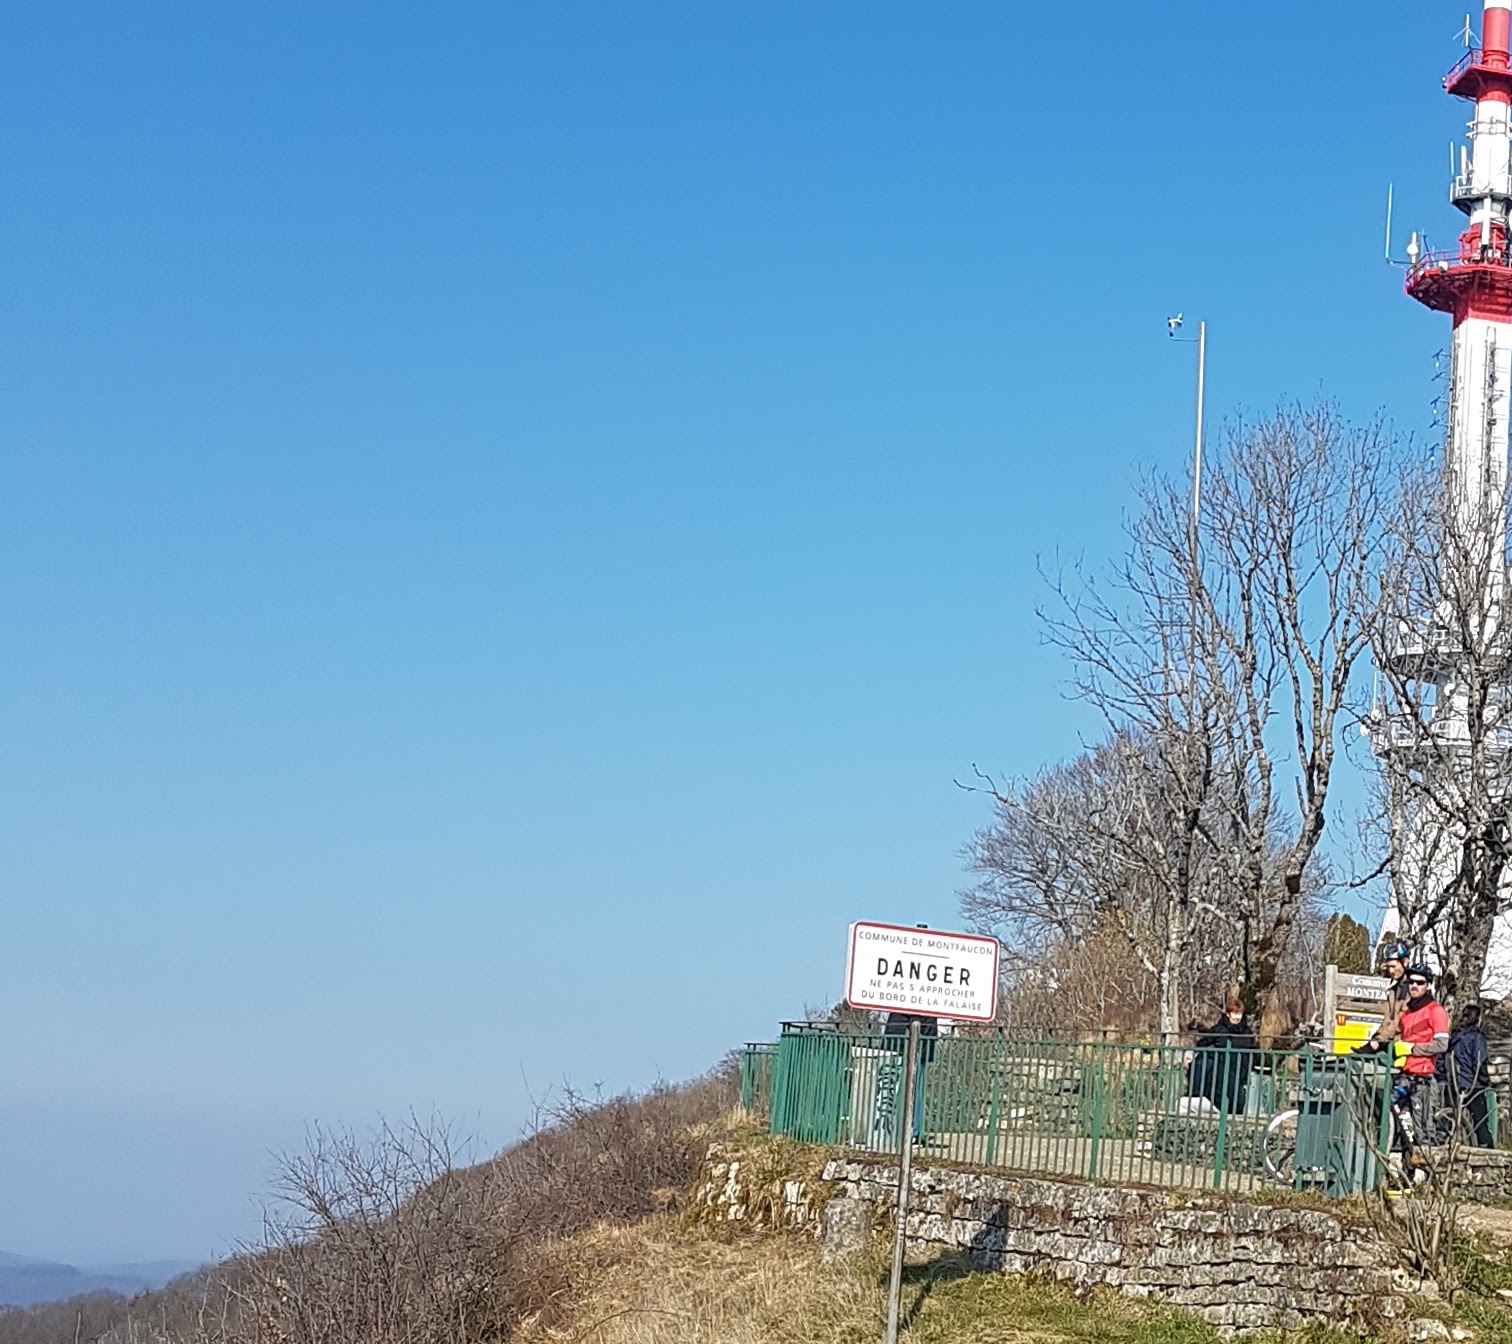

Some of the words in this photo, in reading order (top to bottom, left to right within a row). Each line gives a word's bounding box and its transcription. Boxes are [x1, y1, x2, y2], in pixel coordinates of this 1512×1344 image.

[858, 931, 908, 945] COMMUNE
[911, 937, 923, 947] DE
[927, 940, 993, 956] MONTFAUCON
[877, 957, 971, 986] DANGER
[870, 979, 881, 988] NE
[886, 980, 904, 991] PAS
[1352, 976, 1390, 988] Commu
[861, 990, 875, 999] DU
[879, 991, 906, 1003] BORD
[911, 995, 922, 1005] DE
[927, 997, 938, 1006] LA
[944, 999, 982, 1011] FALAISE
[1347, 987, 1388, 1000] MONTFA
